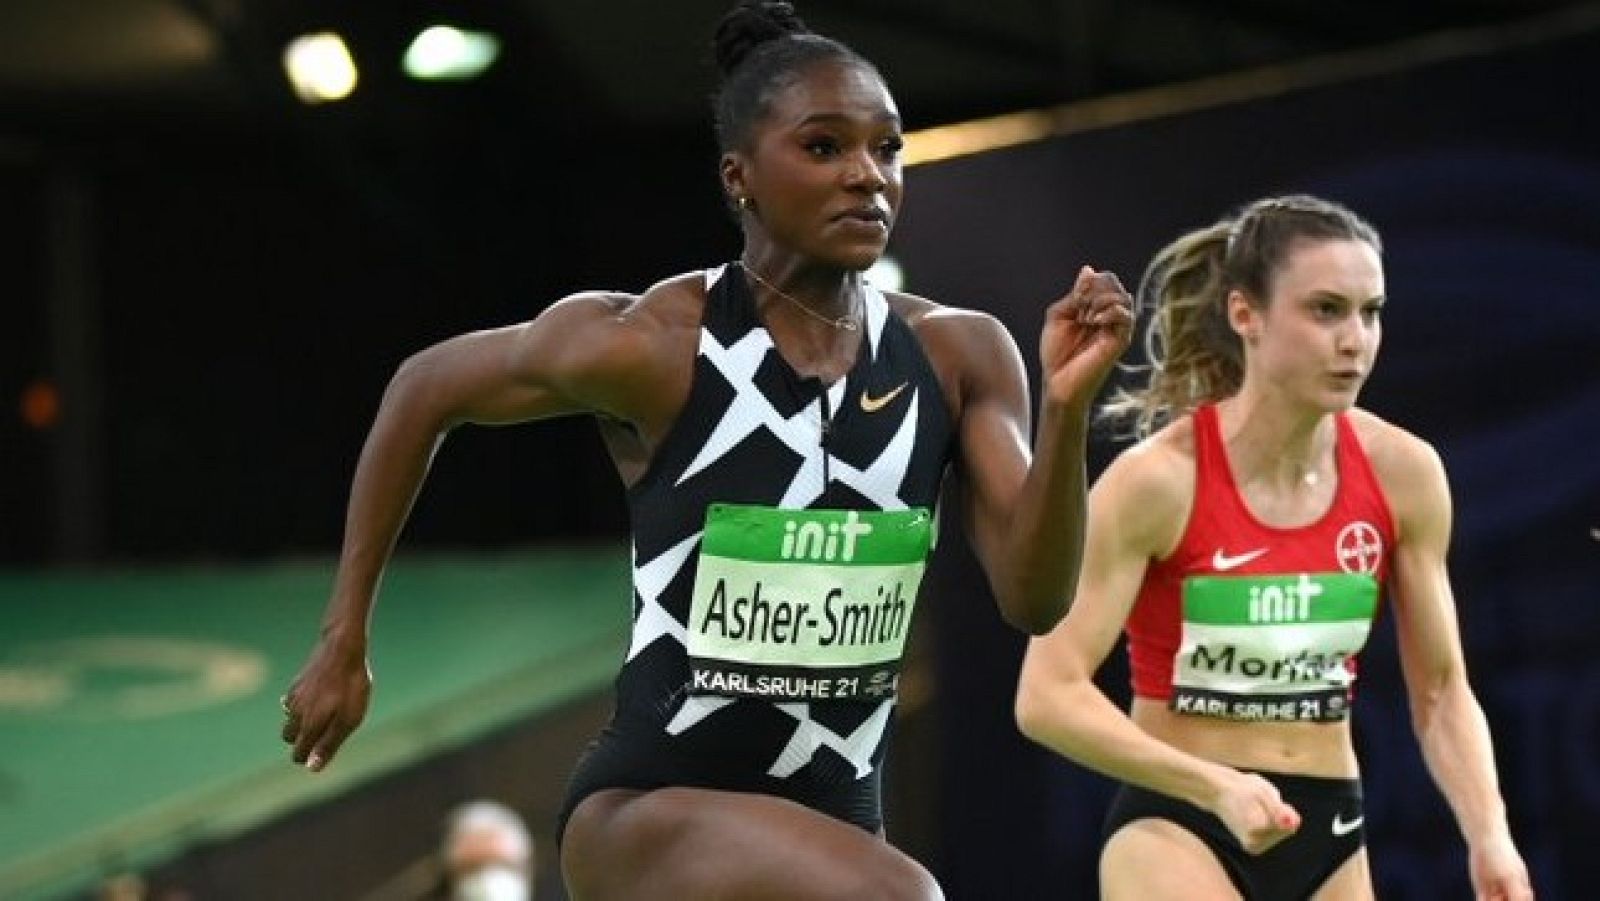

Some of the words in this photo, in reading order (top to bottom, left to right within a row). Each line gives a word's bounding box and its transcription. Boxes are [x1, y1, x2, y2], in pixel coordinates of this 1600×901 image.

[780, 510, 873, 562] init
[701, 577, 905, 646] Asher-Smith
[1249, 573, 1323, 622] init
[693, 669, 831, 698] KARLSRUHE
[836, 676, 858, 698] 21
